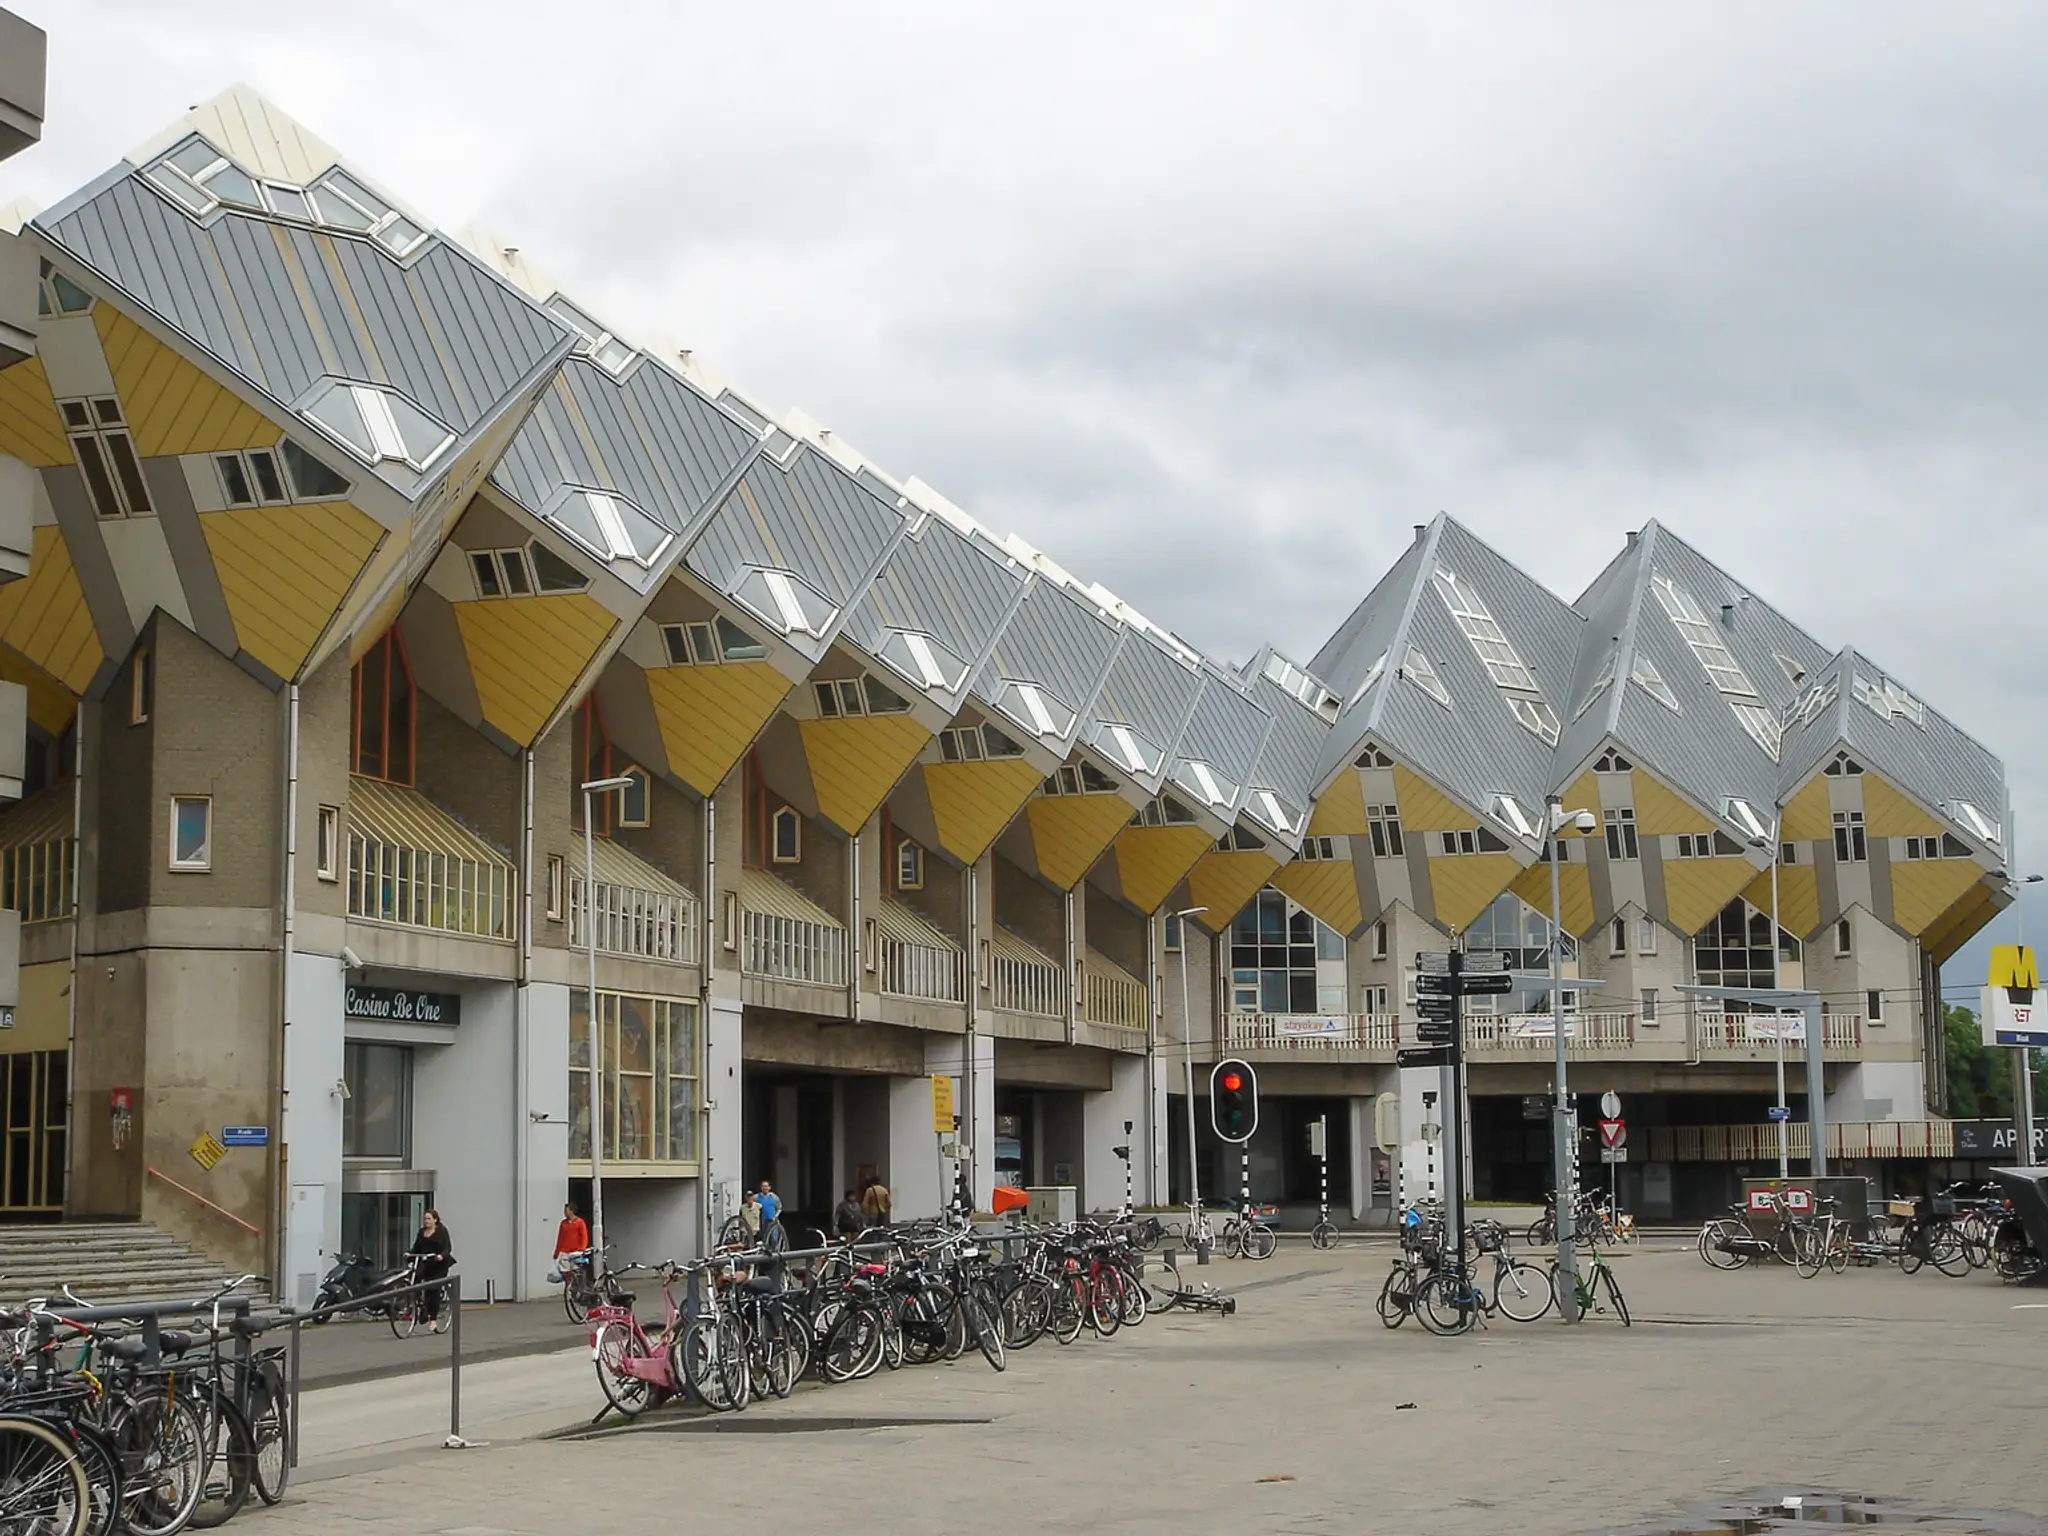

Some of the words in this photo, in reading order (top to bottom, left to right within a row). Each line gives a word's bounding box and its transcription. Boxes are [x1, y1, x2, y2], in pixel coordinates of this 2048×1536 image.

[345, 987, 390, 1017] Casino
[392, 992, 413, 1018] Be
[416, 994, 440, 1021] One
